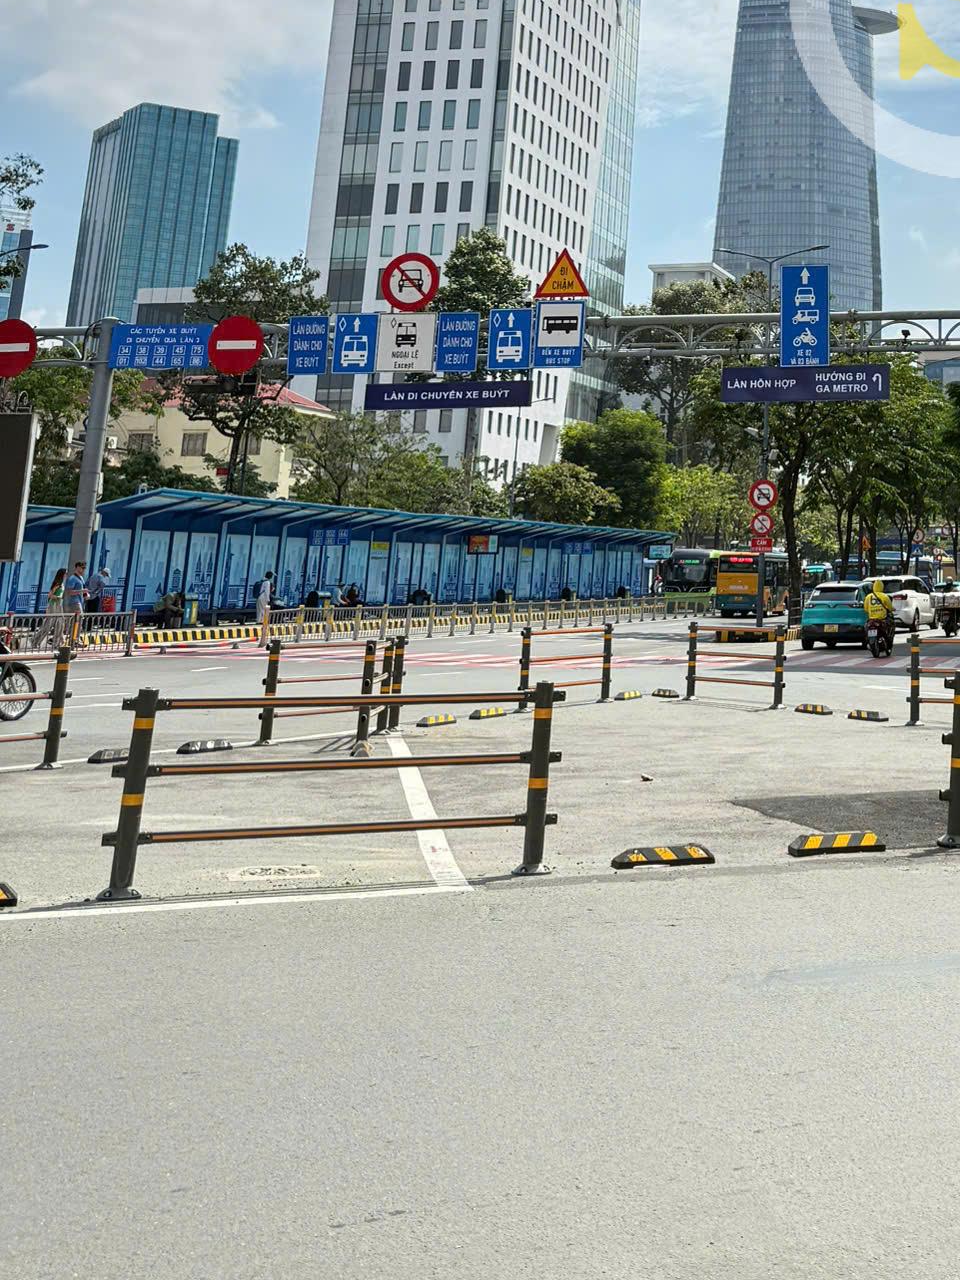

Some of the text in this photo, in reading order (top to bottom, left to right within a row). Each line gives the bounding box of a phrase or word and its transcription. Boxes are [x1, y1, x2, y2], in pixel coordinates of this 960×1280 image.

[560, 266, 568, 276] ĐI
[552, 277, 574, 292] CHẬM
[130, 326, 143, 334] CÁC
[293, 321, 305, 335] LÀN
[441, 318, 455, 332] LÀN
[293, 338, 323, 351] DÀNH CHO
[442, 334, 473, 348] DÀNH CHO
[295, 354, 319, 368] XE BUÝT
[444, 351, 469, 365] XE BUÝT
[394, 361, 414, 370] Except
[815, 371, 867, 382] HƯỚNG ĐI
[727, 378, 748, 389] LÀN
[774, 378, 797, 389] HỢP
[815, 383, 868, 394] GA METRO
[384, 390, 405, 401] LÀN
[407, 391, 418, 400] DI
[465, 390, 479, 399] XE
[482, 387, 510, 399] BUÝT
